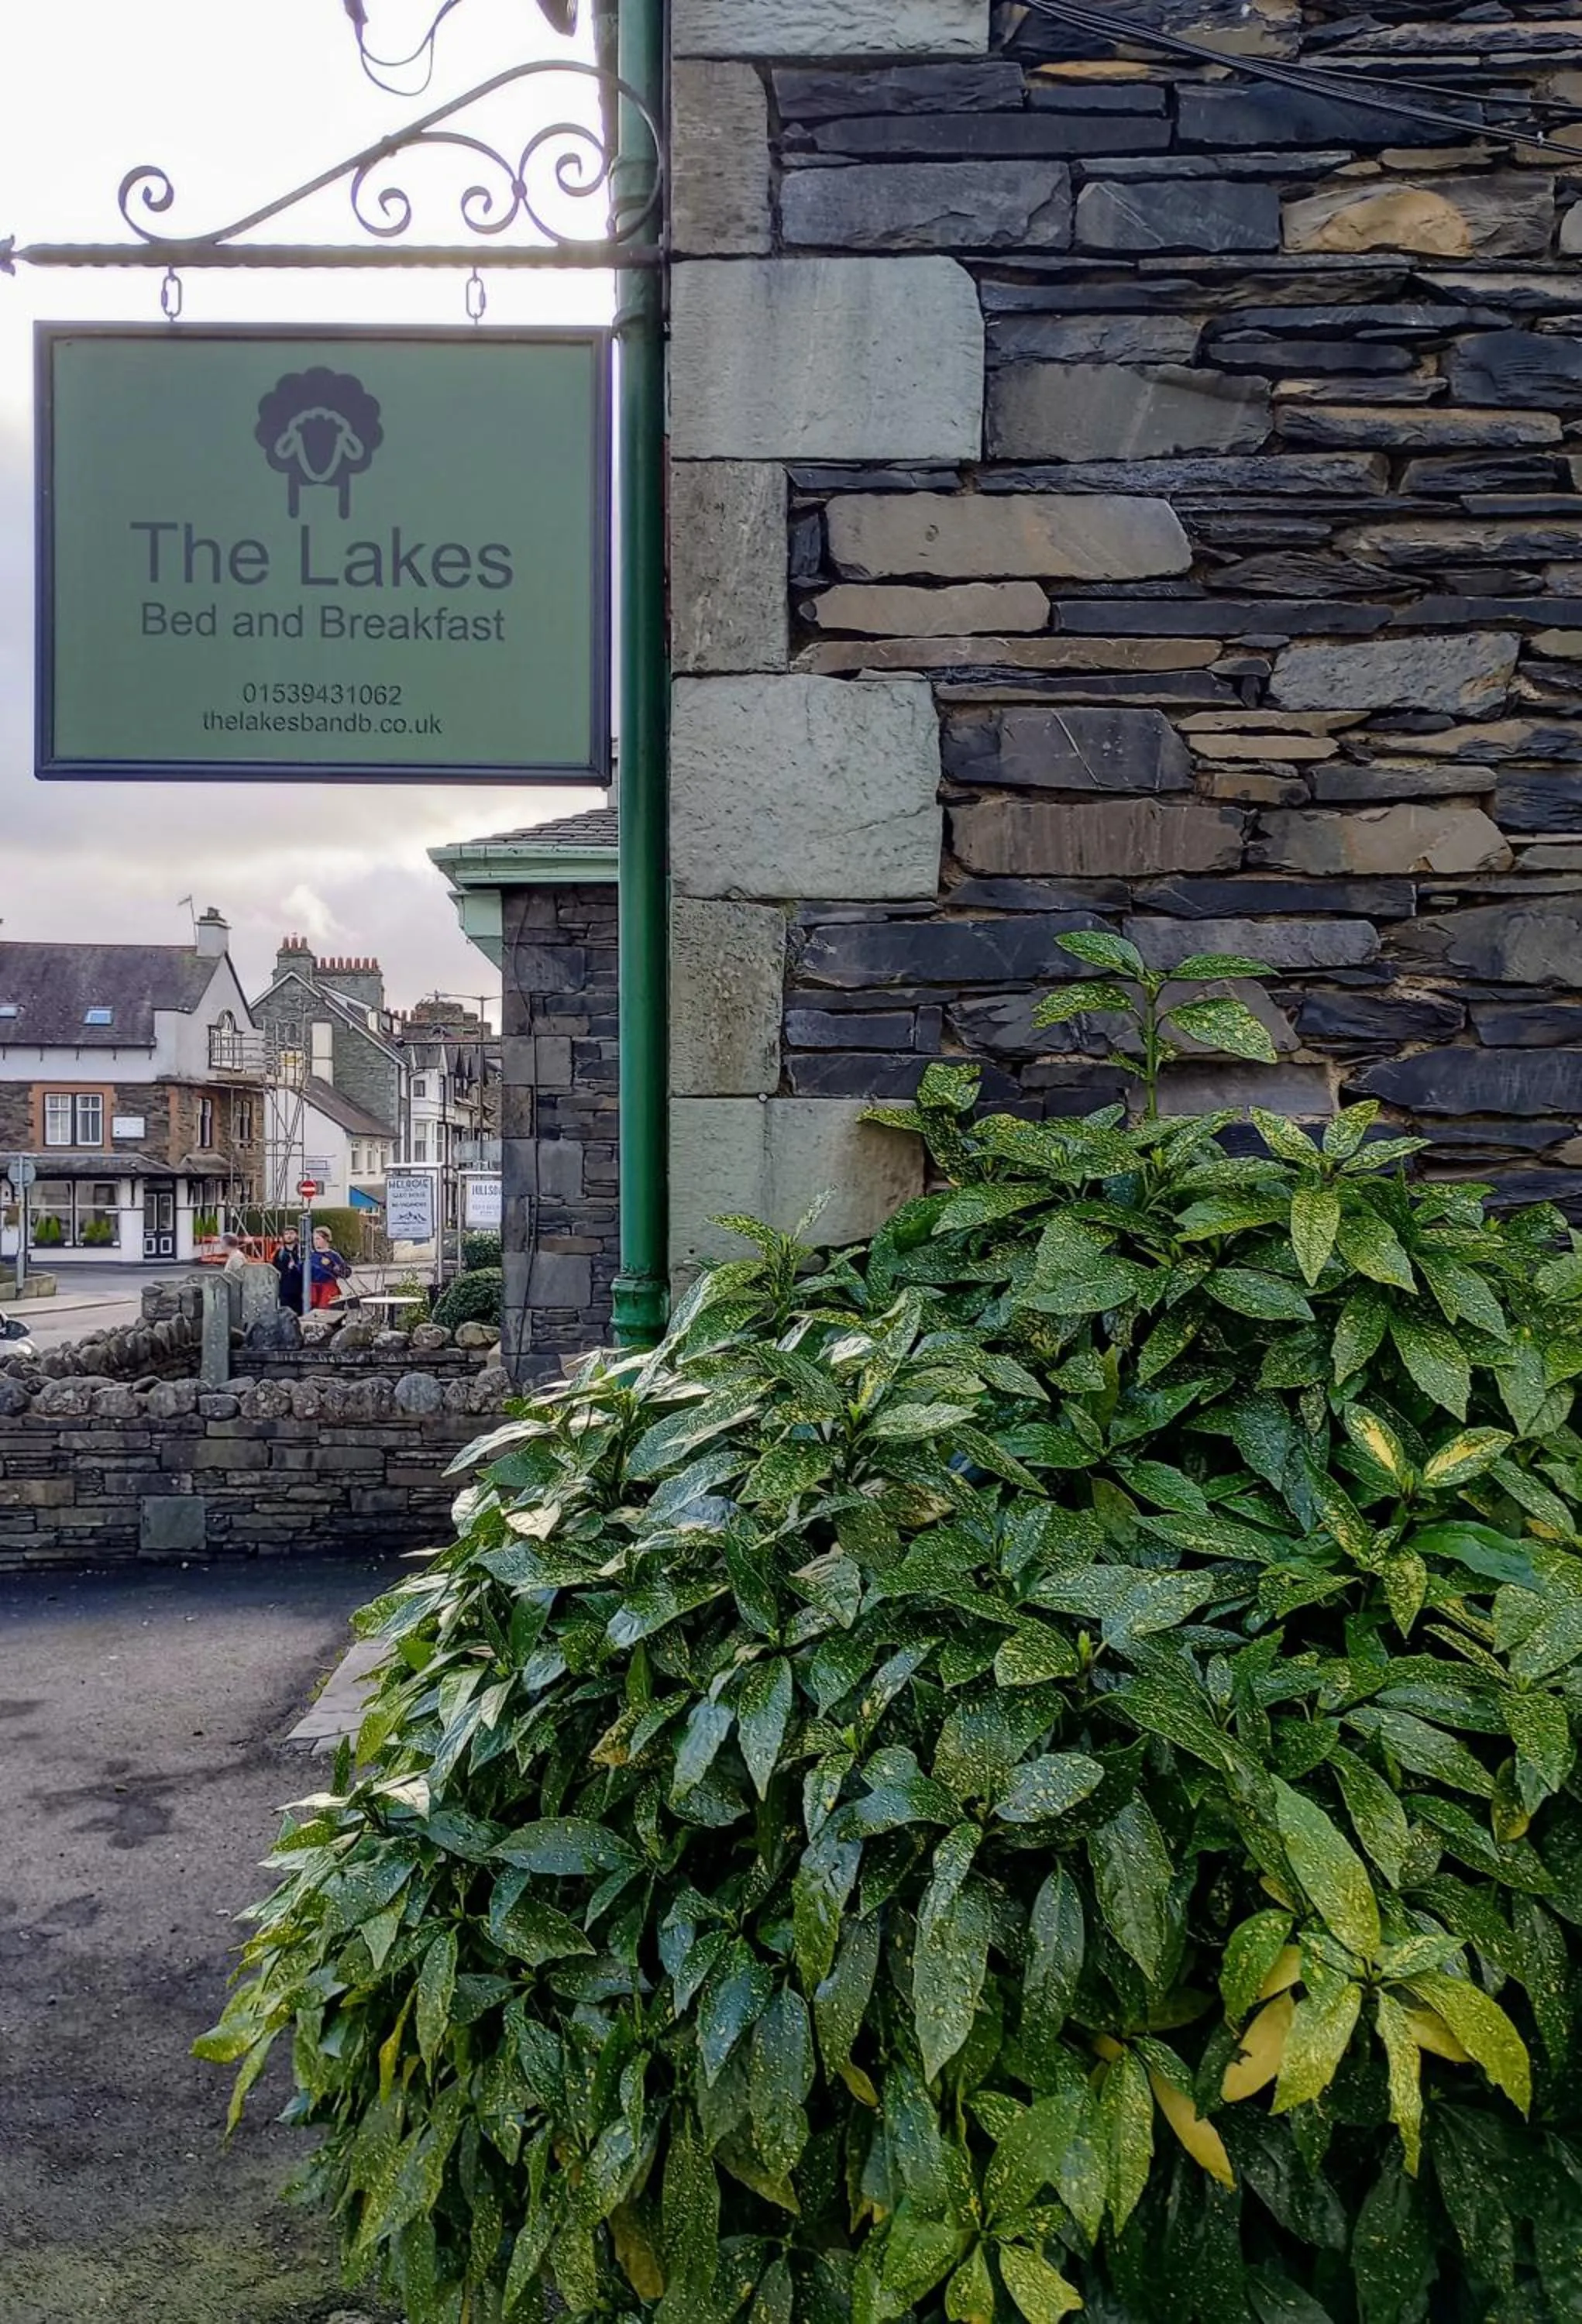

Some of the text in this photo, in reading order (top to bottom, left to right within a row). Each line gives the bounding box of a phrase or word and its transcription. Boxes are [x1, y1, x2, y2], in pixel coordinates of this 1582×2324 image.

[130, 521, 513, 590] The Lakes
[142, 602, 505, 641] Bed and Breakfast
[242, 682, 402, 706] 01539431062
[203, 711, 442, 734] thelakesbandb.co.uk
